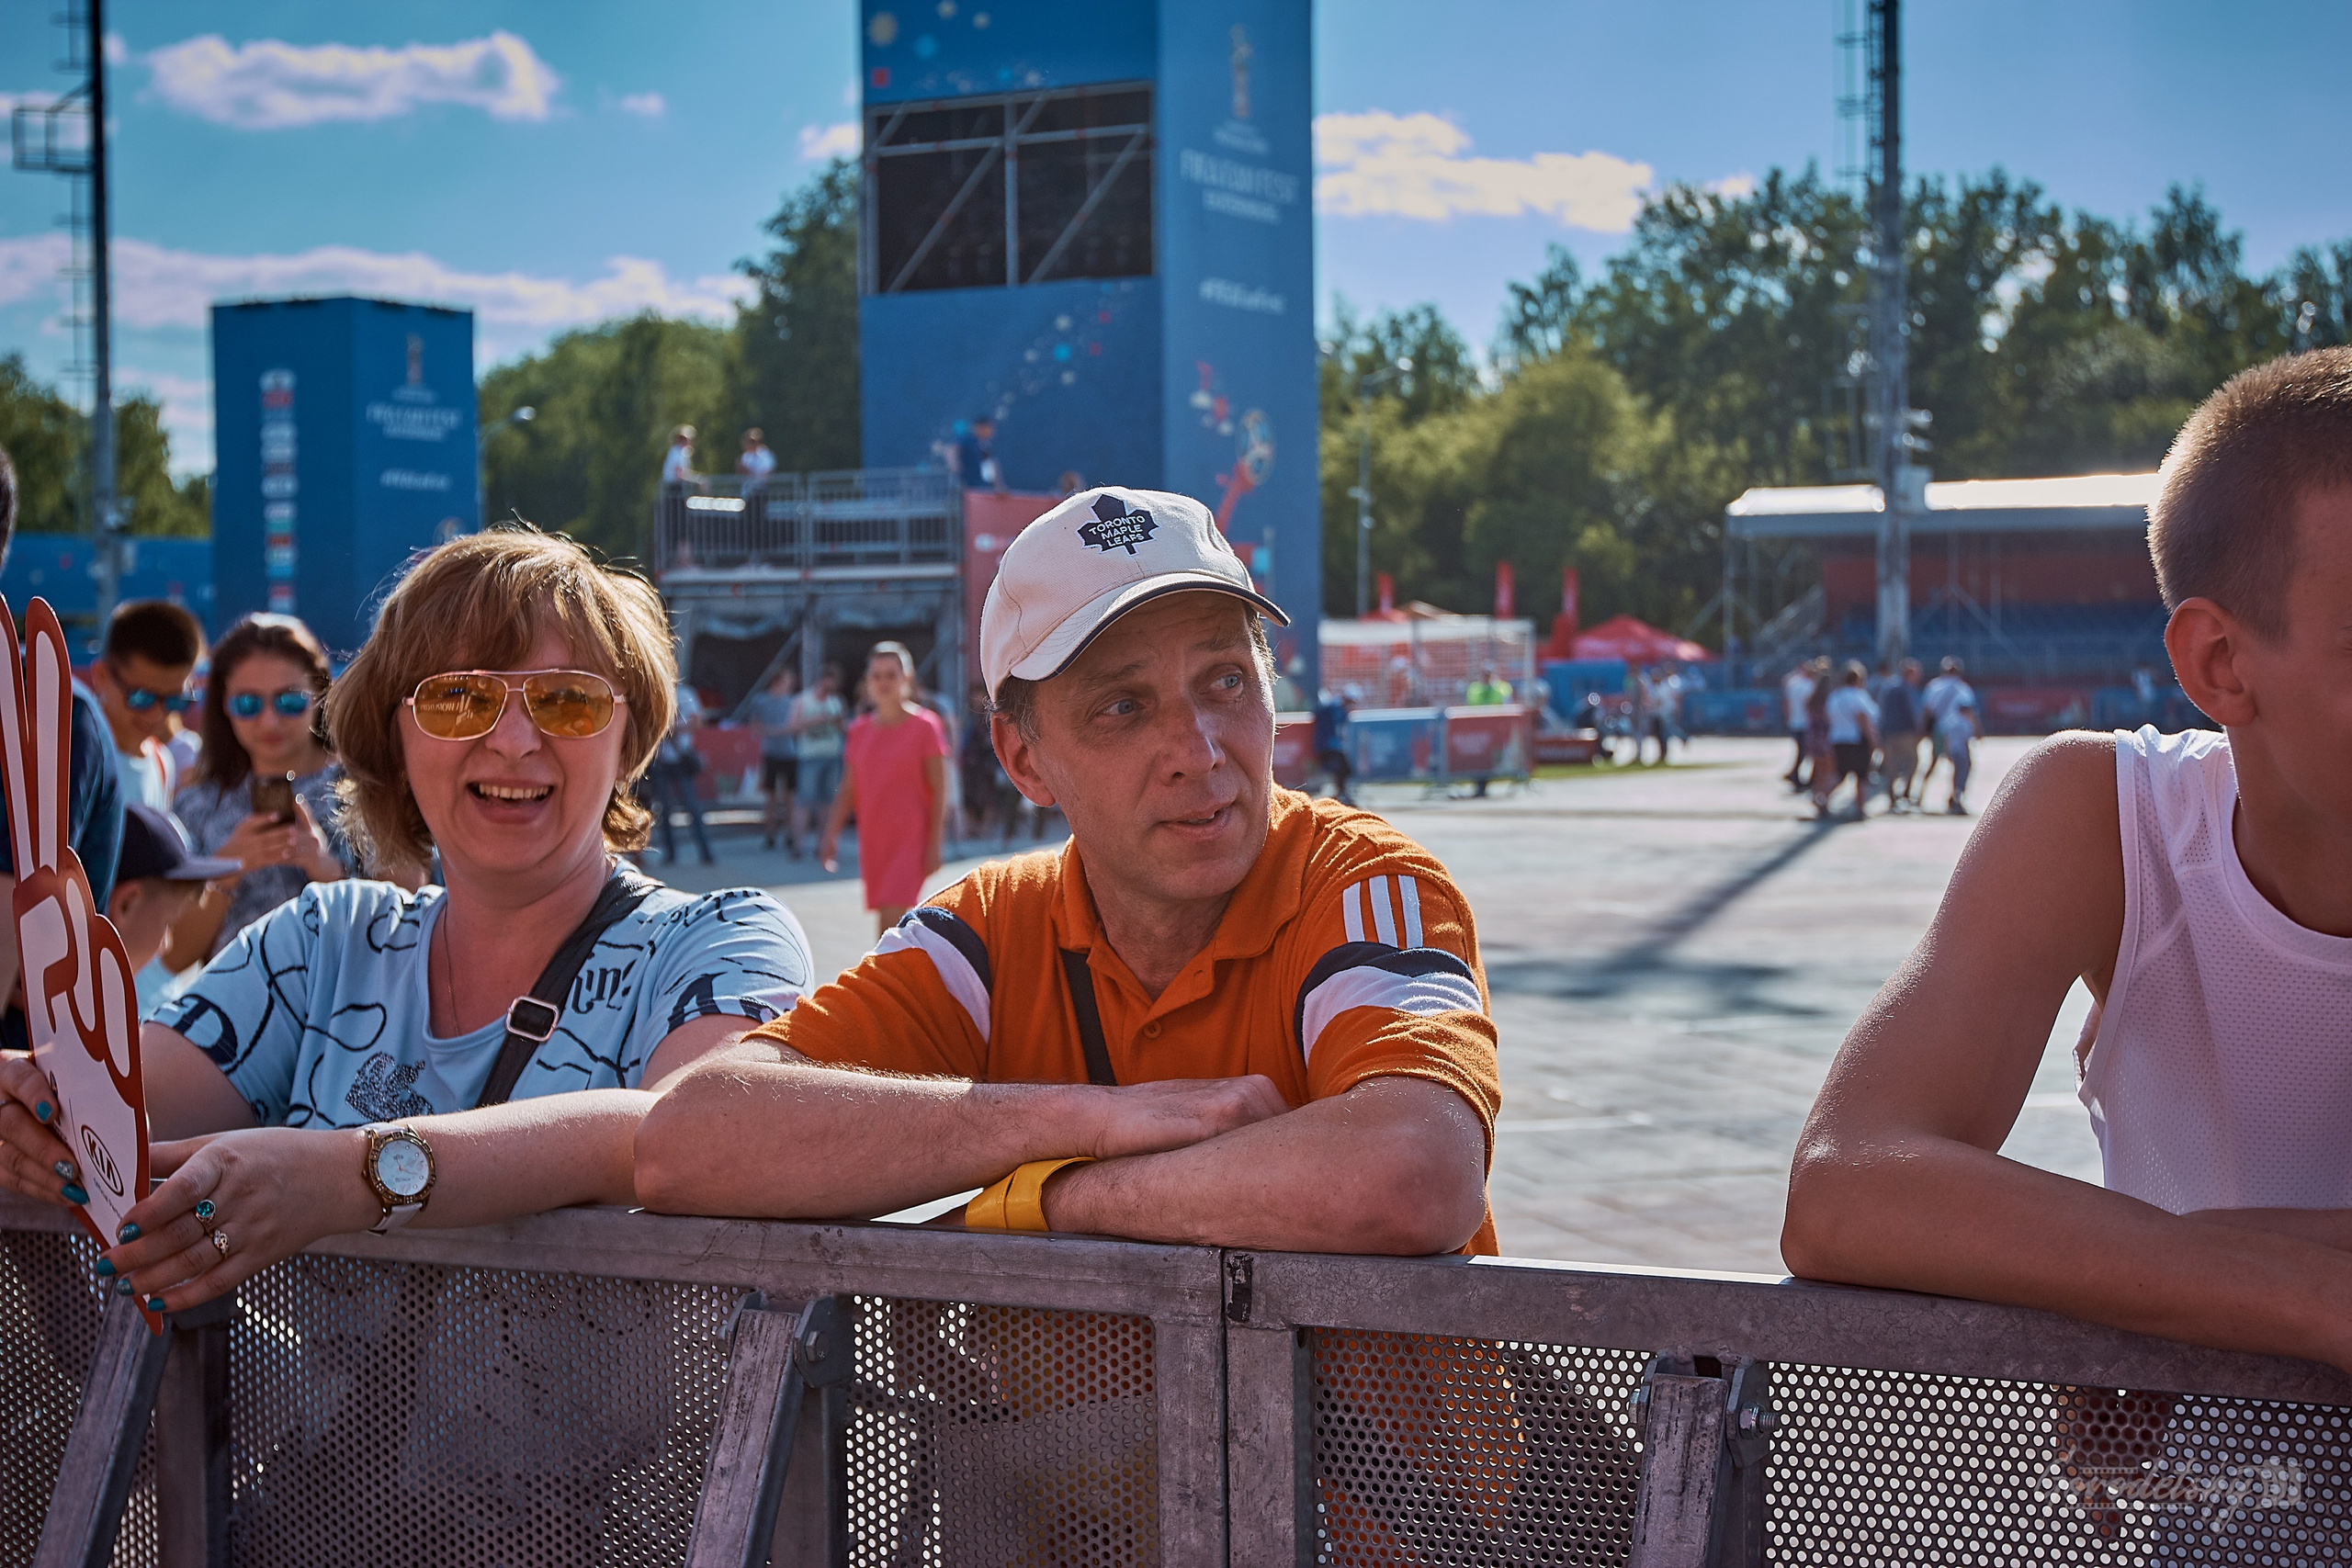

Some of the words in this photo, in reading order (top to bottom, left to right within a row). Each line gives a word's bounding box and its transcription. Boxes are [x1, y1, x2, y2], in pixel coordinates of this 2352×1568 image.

[1088, 515, 1146, 536] TORONTO
[1101, 524, 1144, 540] MAPLE
[1106, 533, 1145, 547] LEAFS
[85, 1131, 119, 1191] KIA
